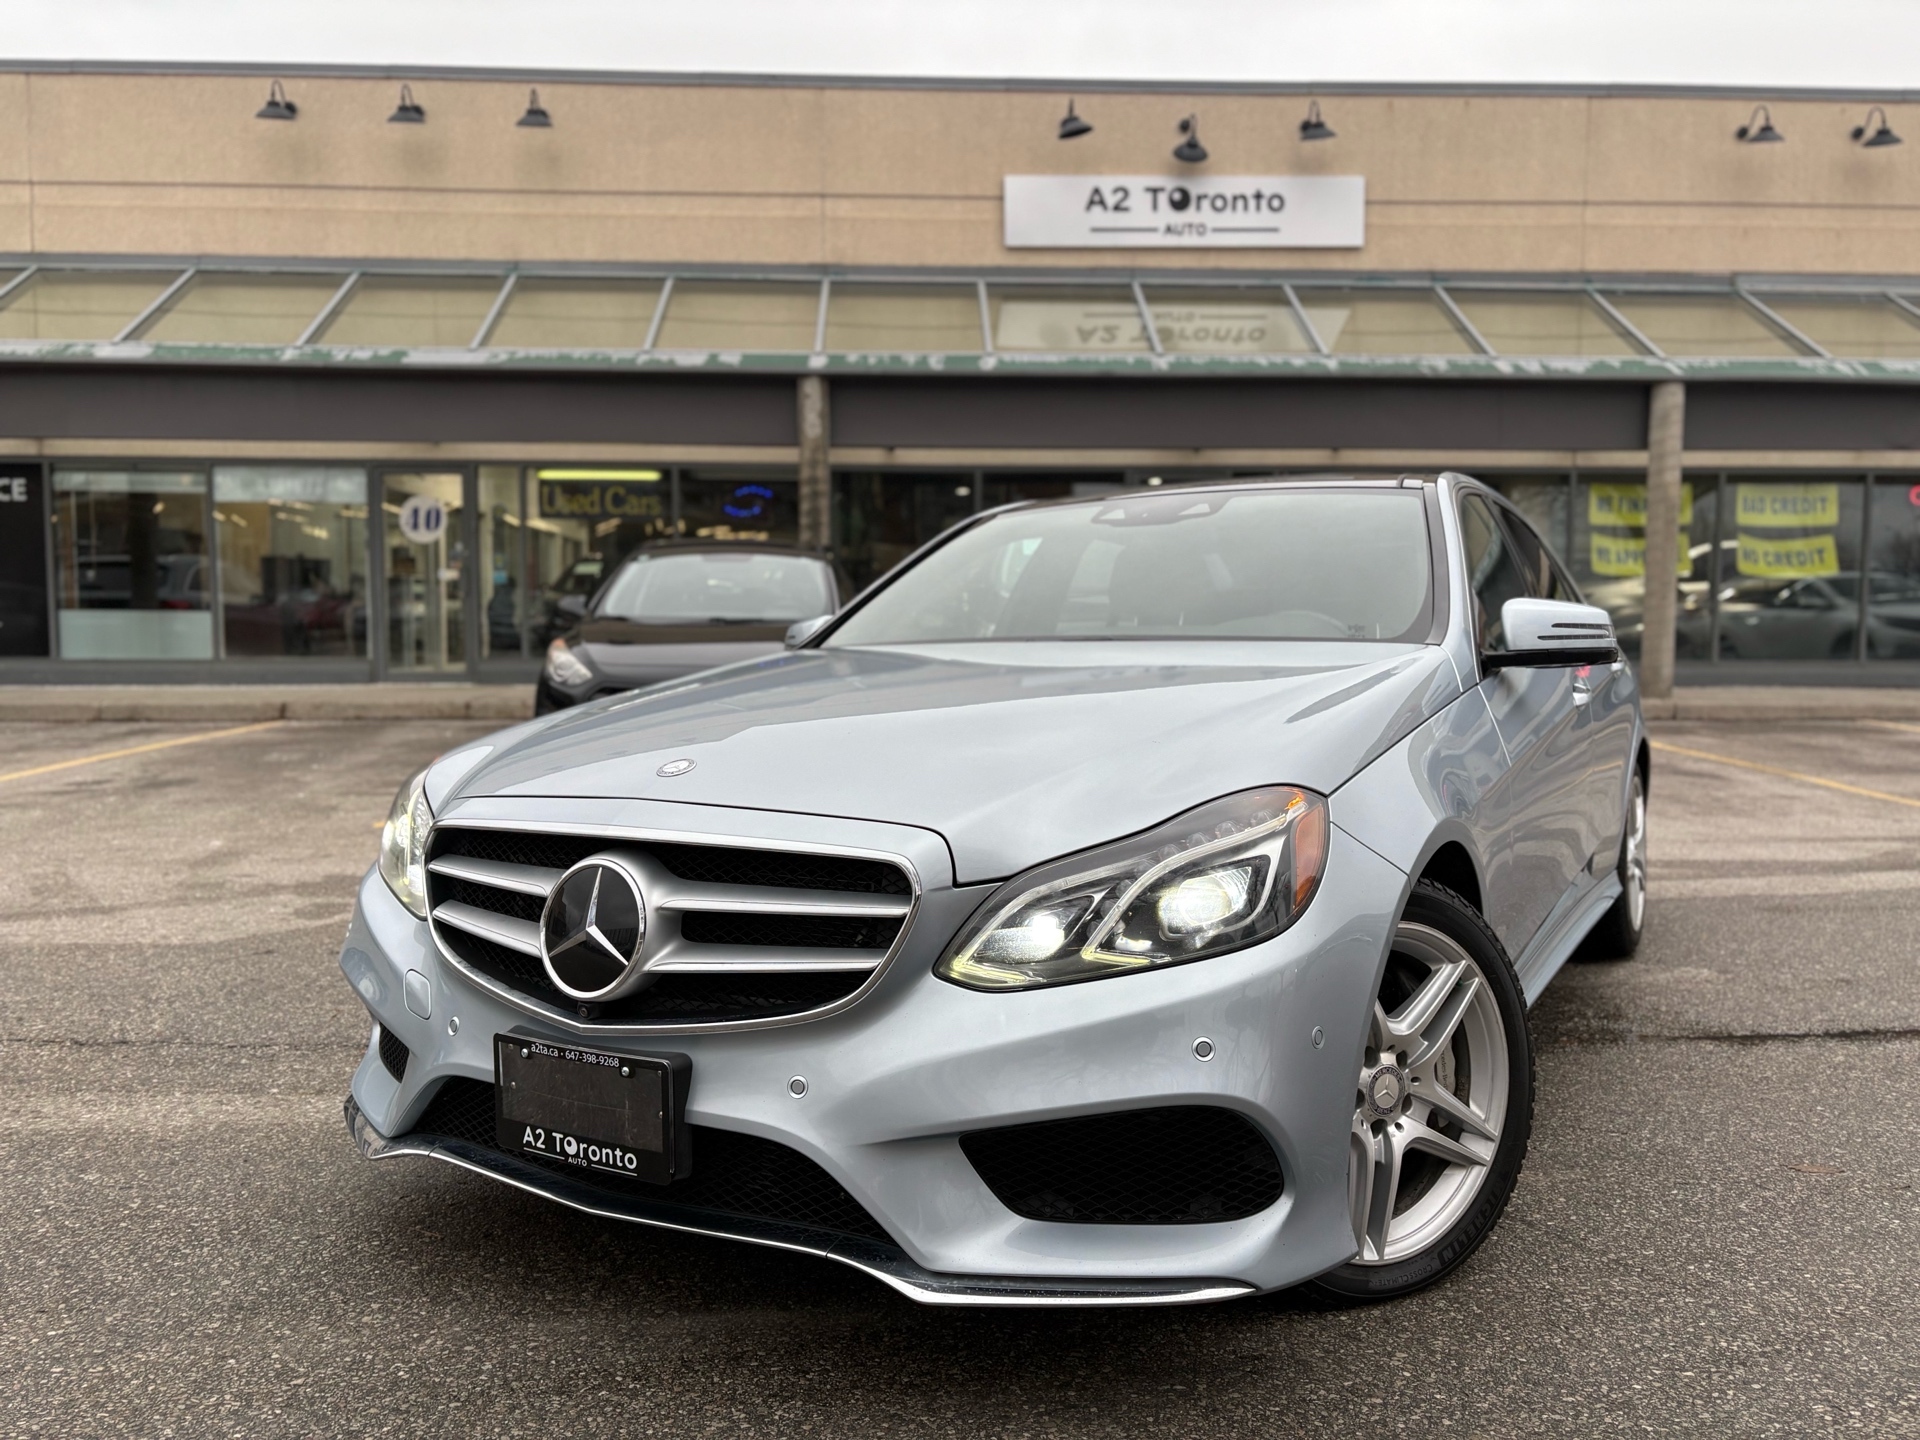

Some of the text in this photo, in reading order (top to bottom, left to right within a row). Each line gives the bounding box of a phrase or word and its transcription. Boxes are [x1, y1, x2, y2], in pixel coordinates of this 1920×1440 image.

[1085, 186, 1131, 212] A2
[1163, 223, 1207, 236] AUTO
[542, 484, 662, 516] Used Cars
[1770, 495, 1828, 516] CREDIT
[1762, 546, 1825, 568] CREDIT
[530, 1043, 620, 1068] a2ta.ca 647-398-9268
[522, 1125, 546, 1149] A2
[568, 1156, 588, 1167] AUTO
